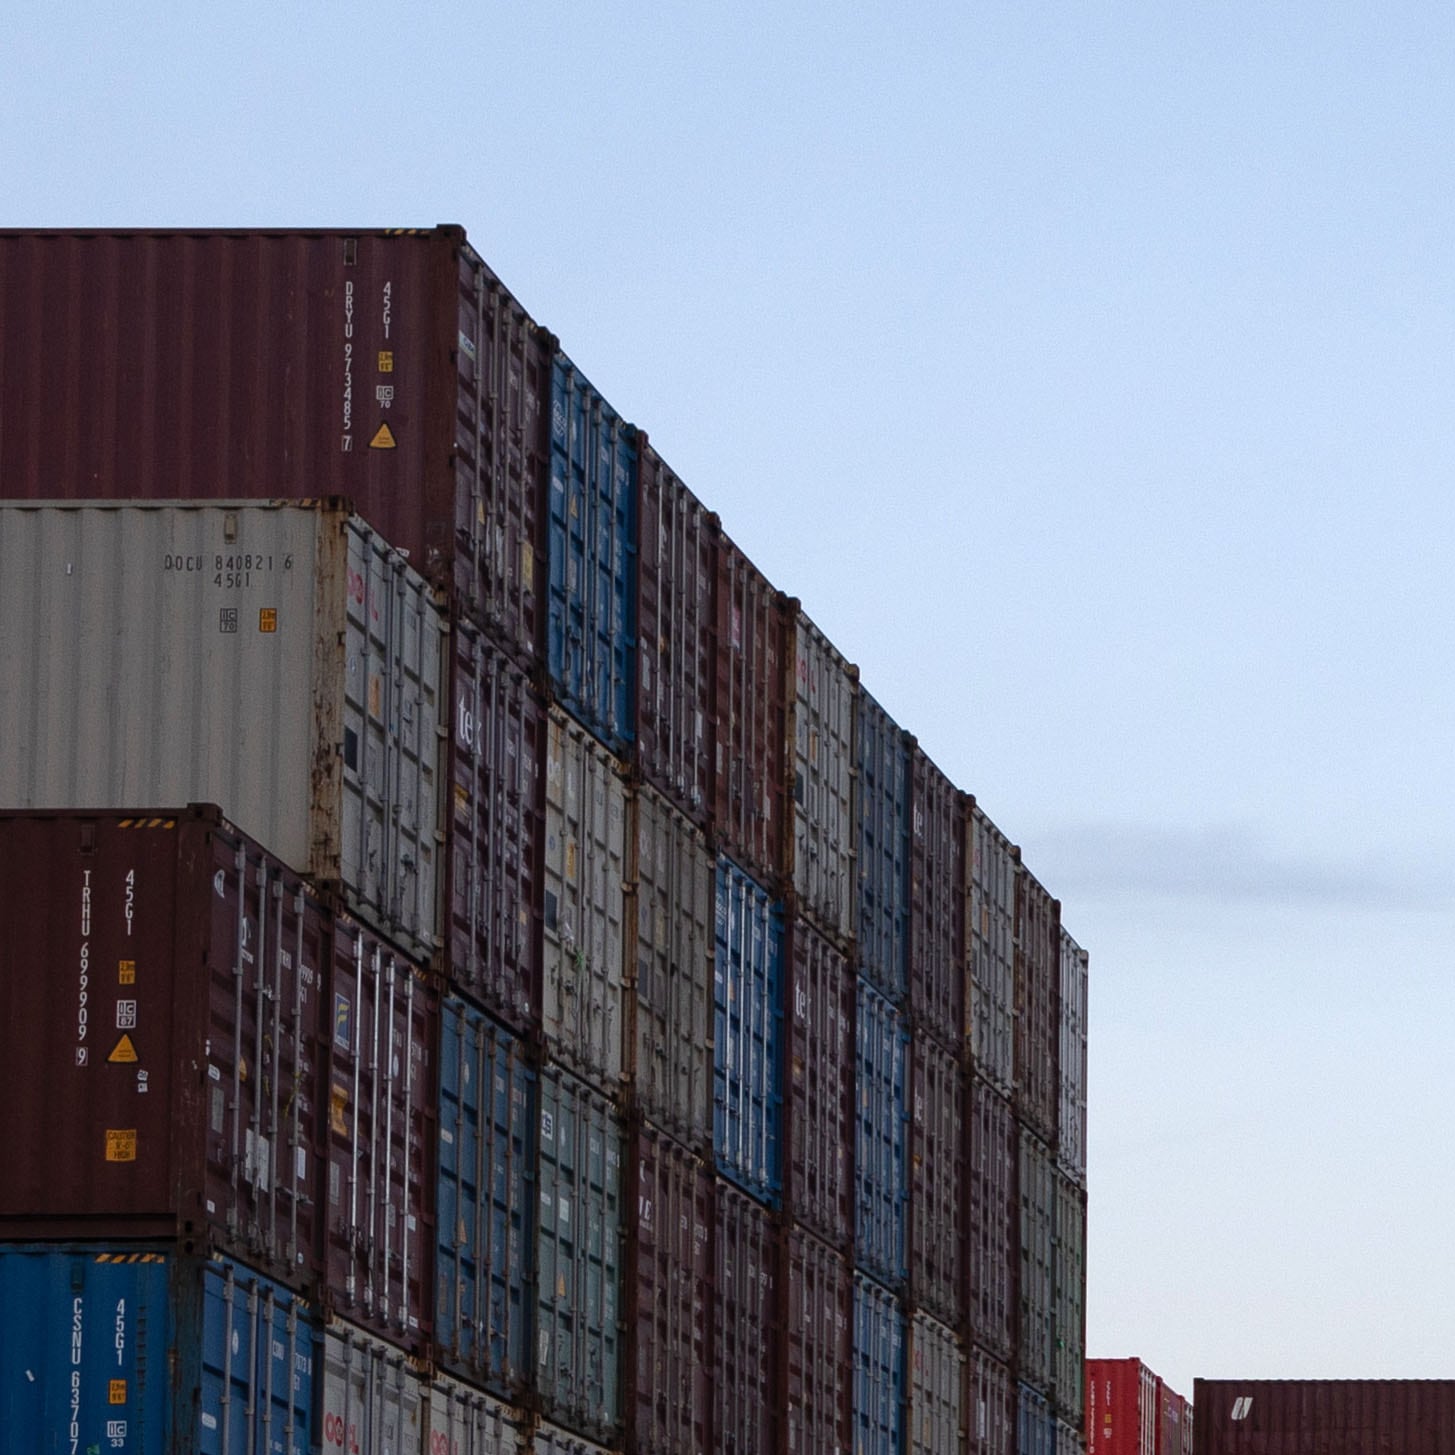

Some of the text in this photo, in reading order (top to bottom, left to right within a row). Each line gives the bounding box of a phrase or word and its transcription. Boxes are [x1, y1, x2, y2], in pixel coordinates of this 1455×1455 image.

[344, 281, 354, 338] DRYU
[382, 281, 392, 340] 45G1
[82, 869, 92, 937] TRHU
[123, 869, 135, 936] 45G1
[76, 942, 90, 1041] 699909
[71, 1298, 83, 1366] CSNU
[114, 1298, 126, 1366] 45G1
[324, 1414, 360, 1455] OOL
